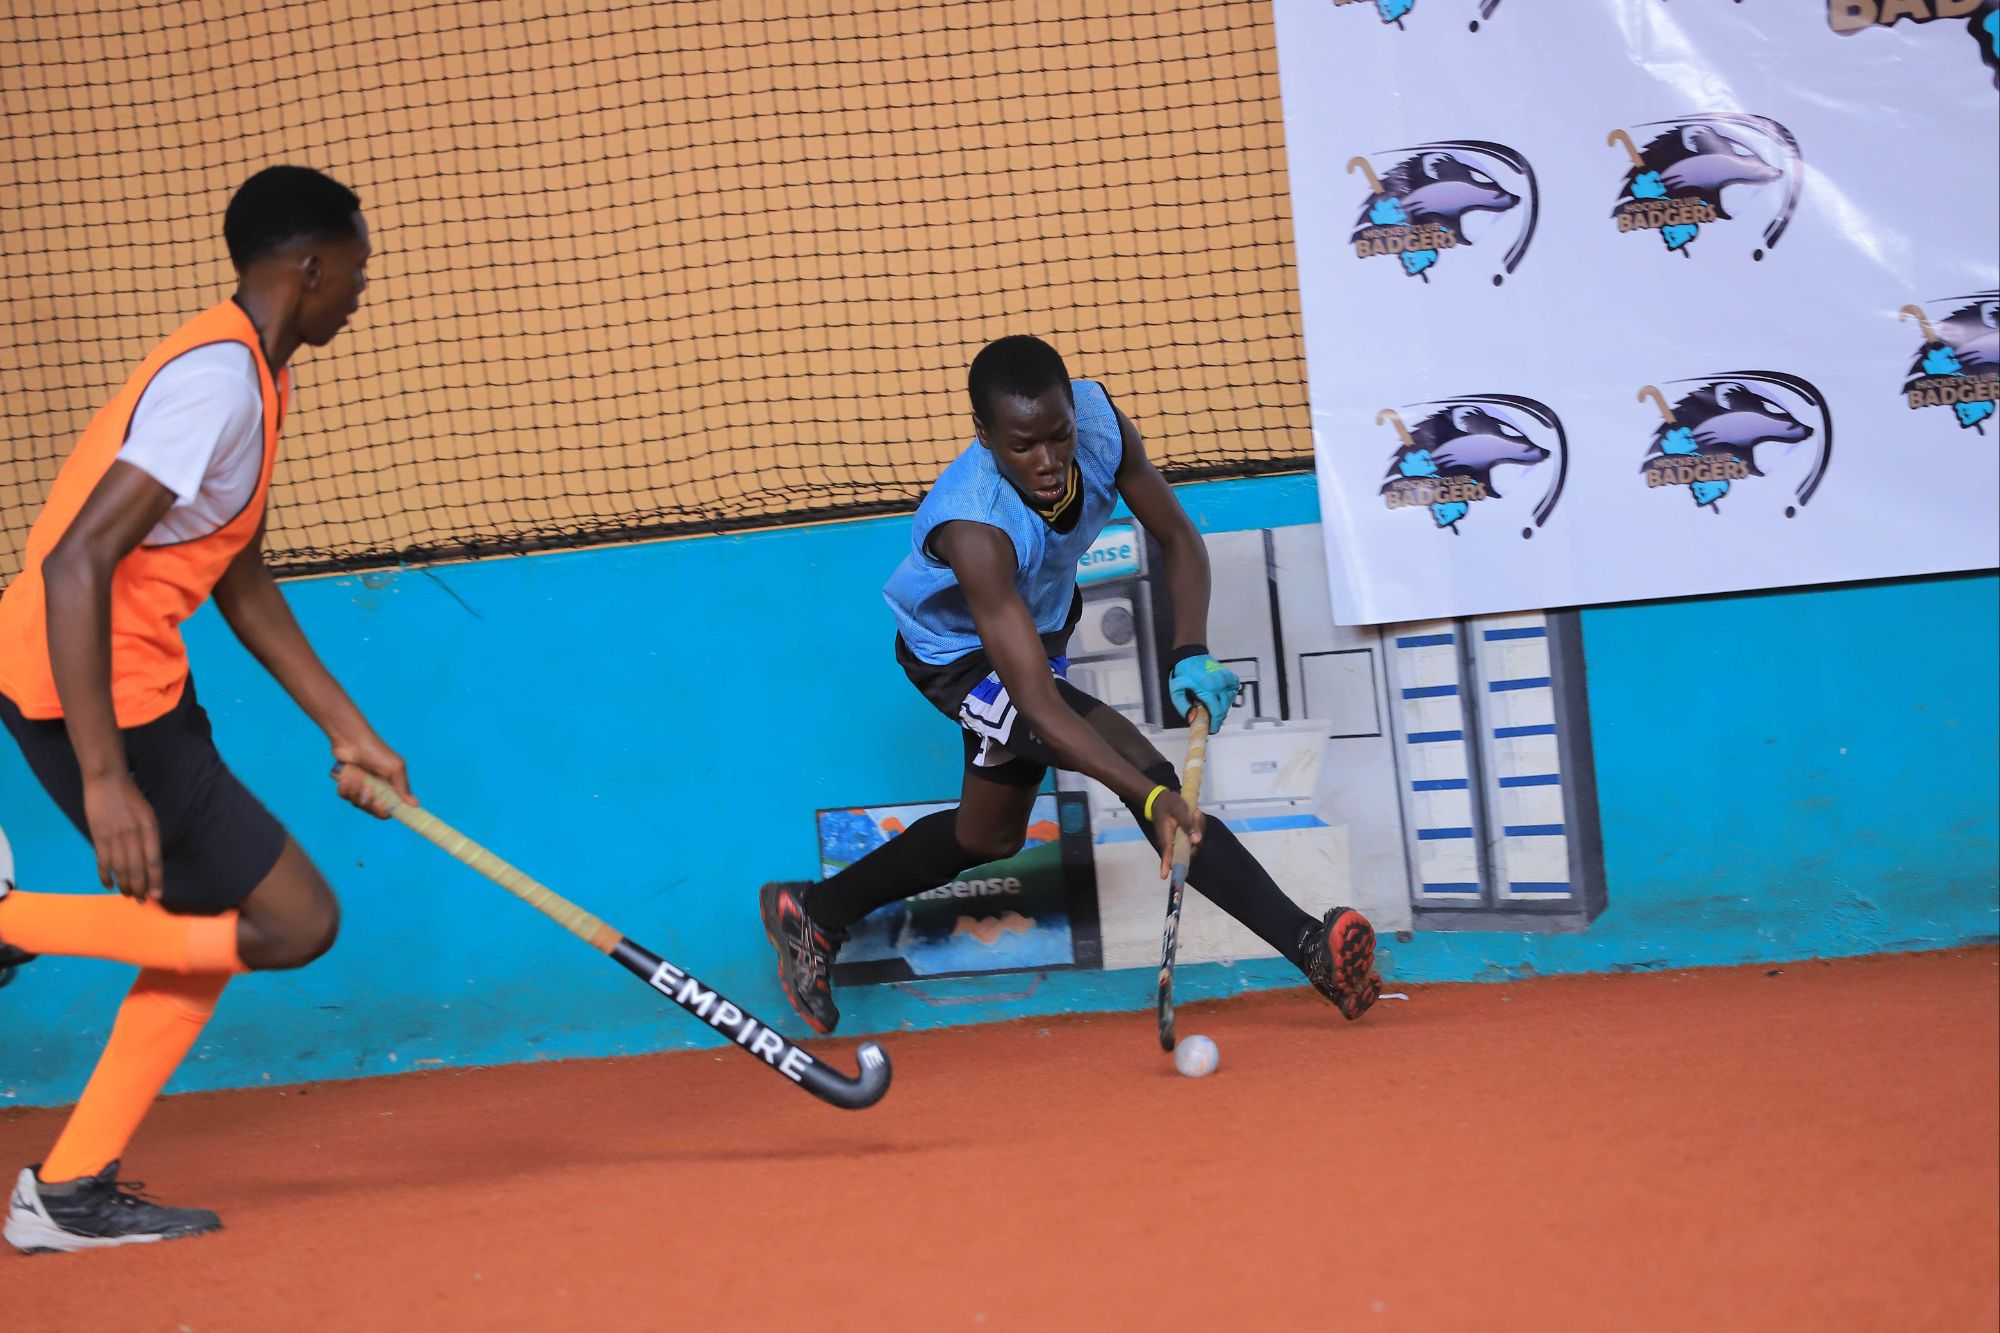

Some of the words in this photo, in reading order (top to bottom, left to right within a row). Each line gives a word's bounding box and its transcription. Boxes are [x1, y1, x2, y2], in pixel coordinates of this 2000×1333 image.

[1618, 203, 1717, 233] BADGERS
[1356, 229, 1457, 258] BADGERS
[1647, 460, 1749, 488] BADGERS
[1386, 482, 1487, 509] BADGERS
[905, 877, 1020, 901] sense
[650, 960, 813, 1082] EMPIRE
